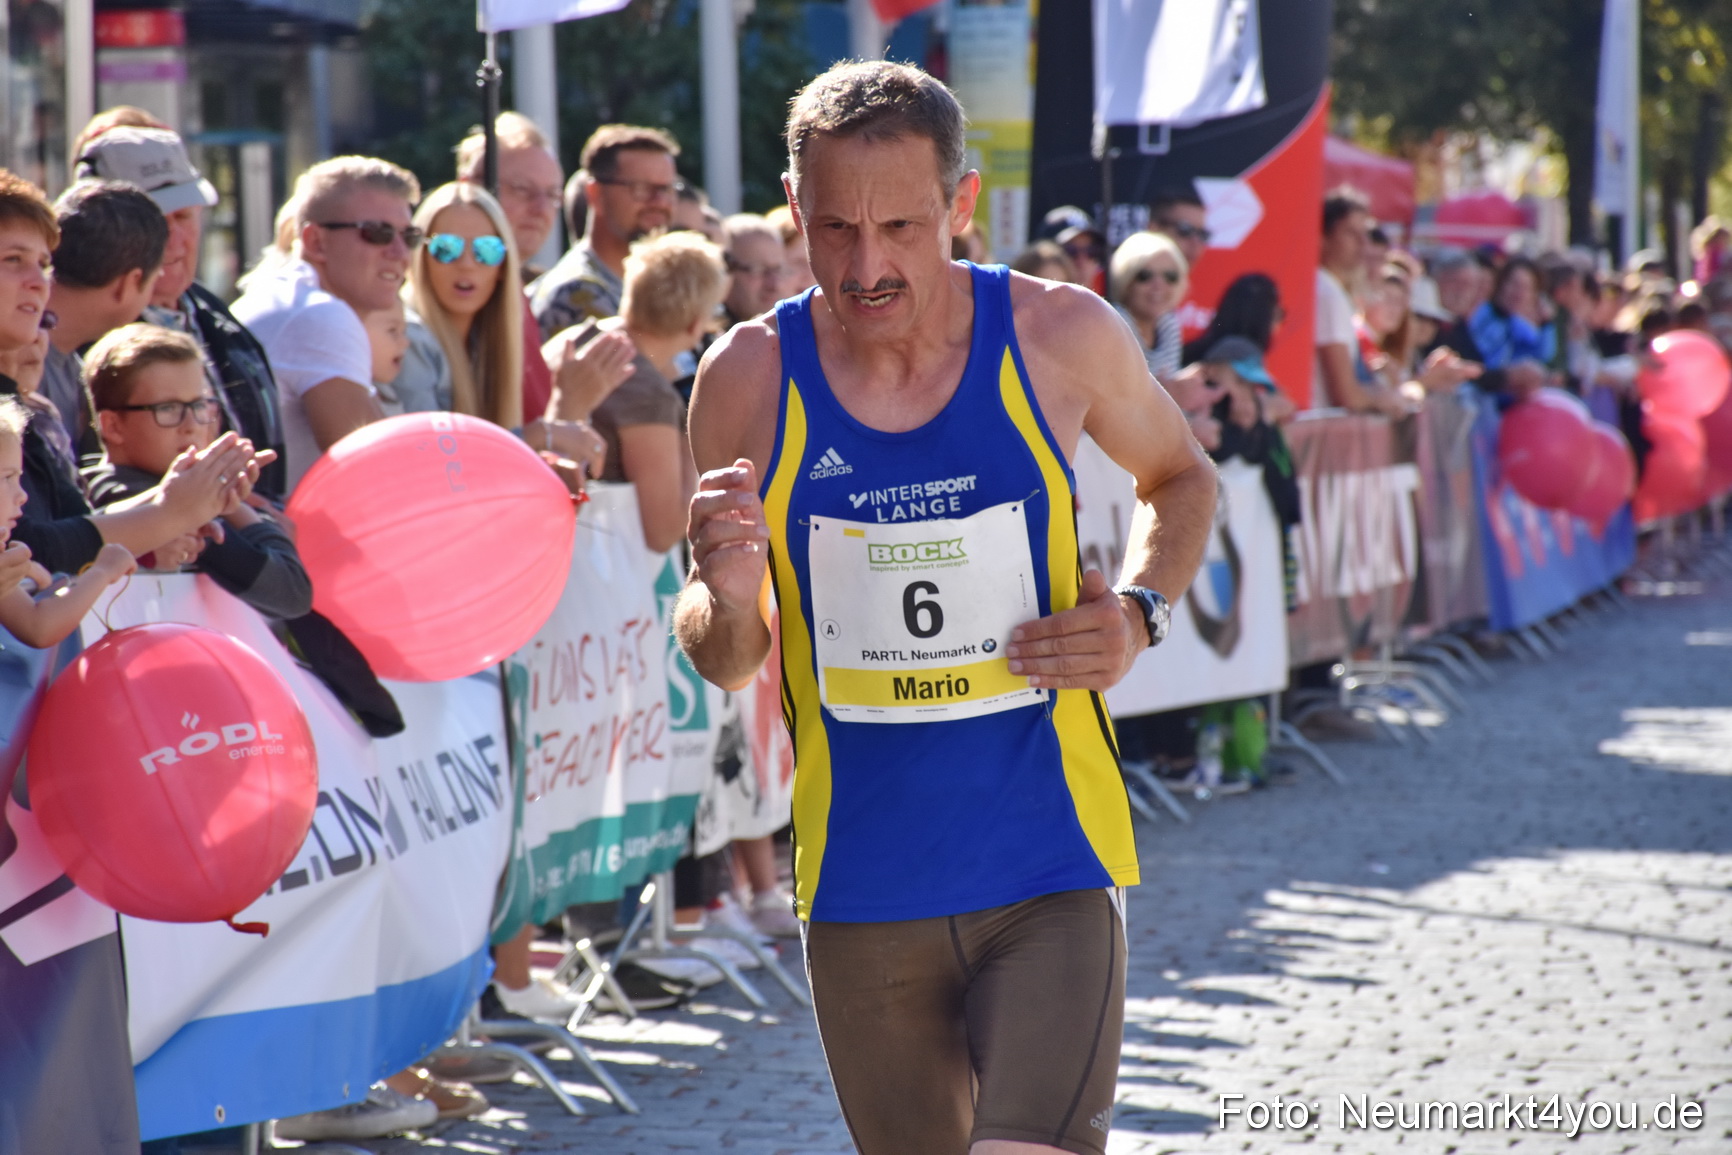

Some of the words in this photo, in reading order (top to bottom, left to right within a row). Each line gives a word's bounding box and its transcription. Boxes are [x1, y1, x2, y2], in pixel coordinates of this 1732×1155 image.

[809, 465, 854, 480] adidas
[870, 475, 977, 506] INTERSPORT
[876, 496, 961, 523] LANGE
[868, 537, 967, 564] BOCK
[869, 564, 899, 573] inspired
[901, 563, 910, 572] by
[912, 563, 934, 571] smart
[936, 559, 970, 569] concepts
[902, 580, 944, 639] 6
[826, 624, 835, 636] A
[862, 650, 909, 661] PARTL
[911, 644, 977, 660] Neumarkt
[893, 673, 970, 701] Mario
[229, 743, 285, 760] energie
